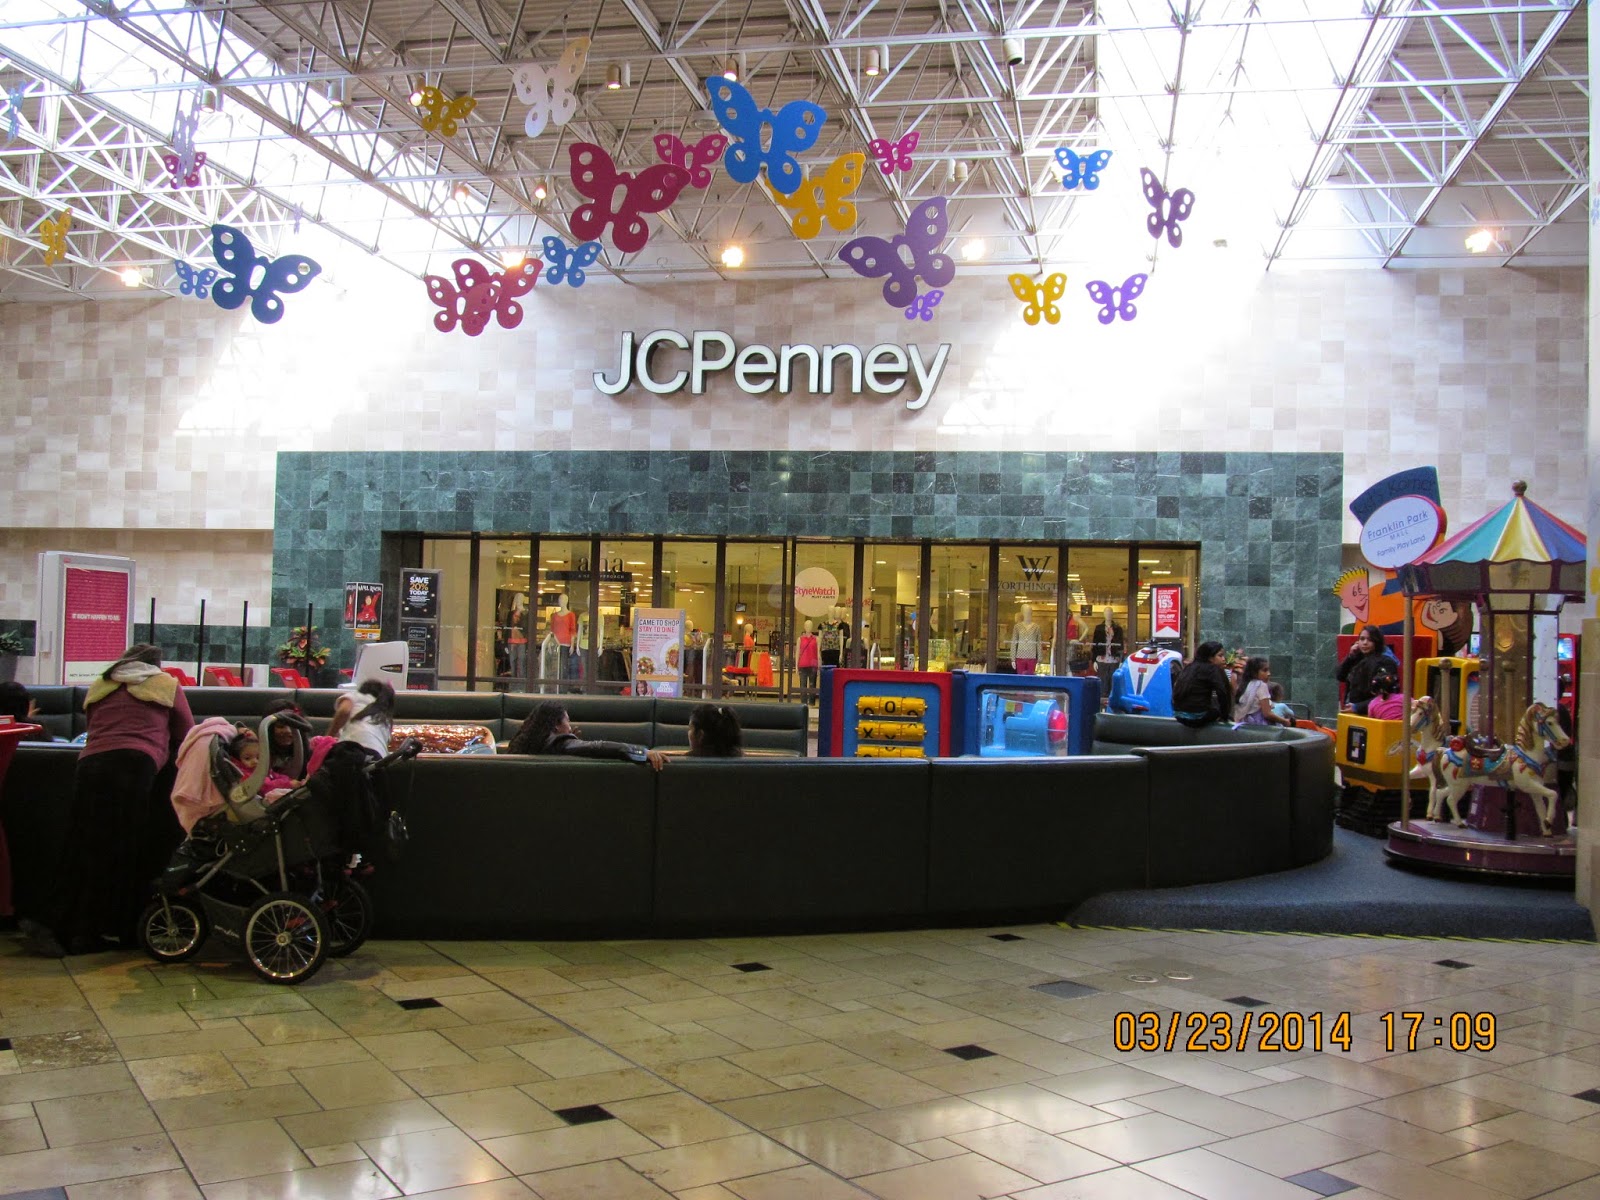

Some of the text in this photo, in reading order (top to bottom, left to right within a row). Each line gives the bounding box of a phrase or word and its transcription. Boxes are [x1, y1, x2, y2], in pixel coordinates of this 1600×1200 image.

[592, 329, 952, 410] JCPenney
[1367, 510, 1428, 539] Franklin Park
[1389, 531, 1409, 540] MALL
[1377, 534, 1426, 557] Family Play Land
[1016, 555, 1052, 581] W
[410, 576, 429, 584] SAVE
[410, 583, 428, 591] 20%
